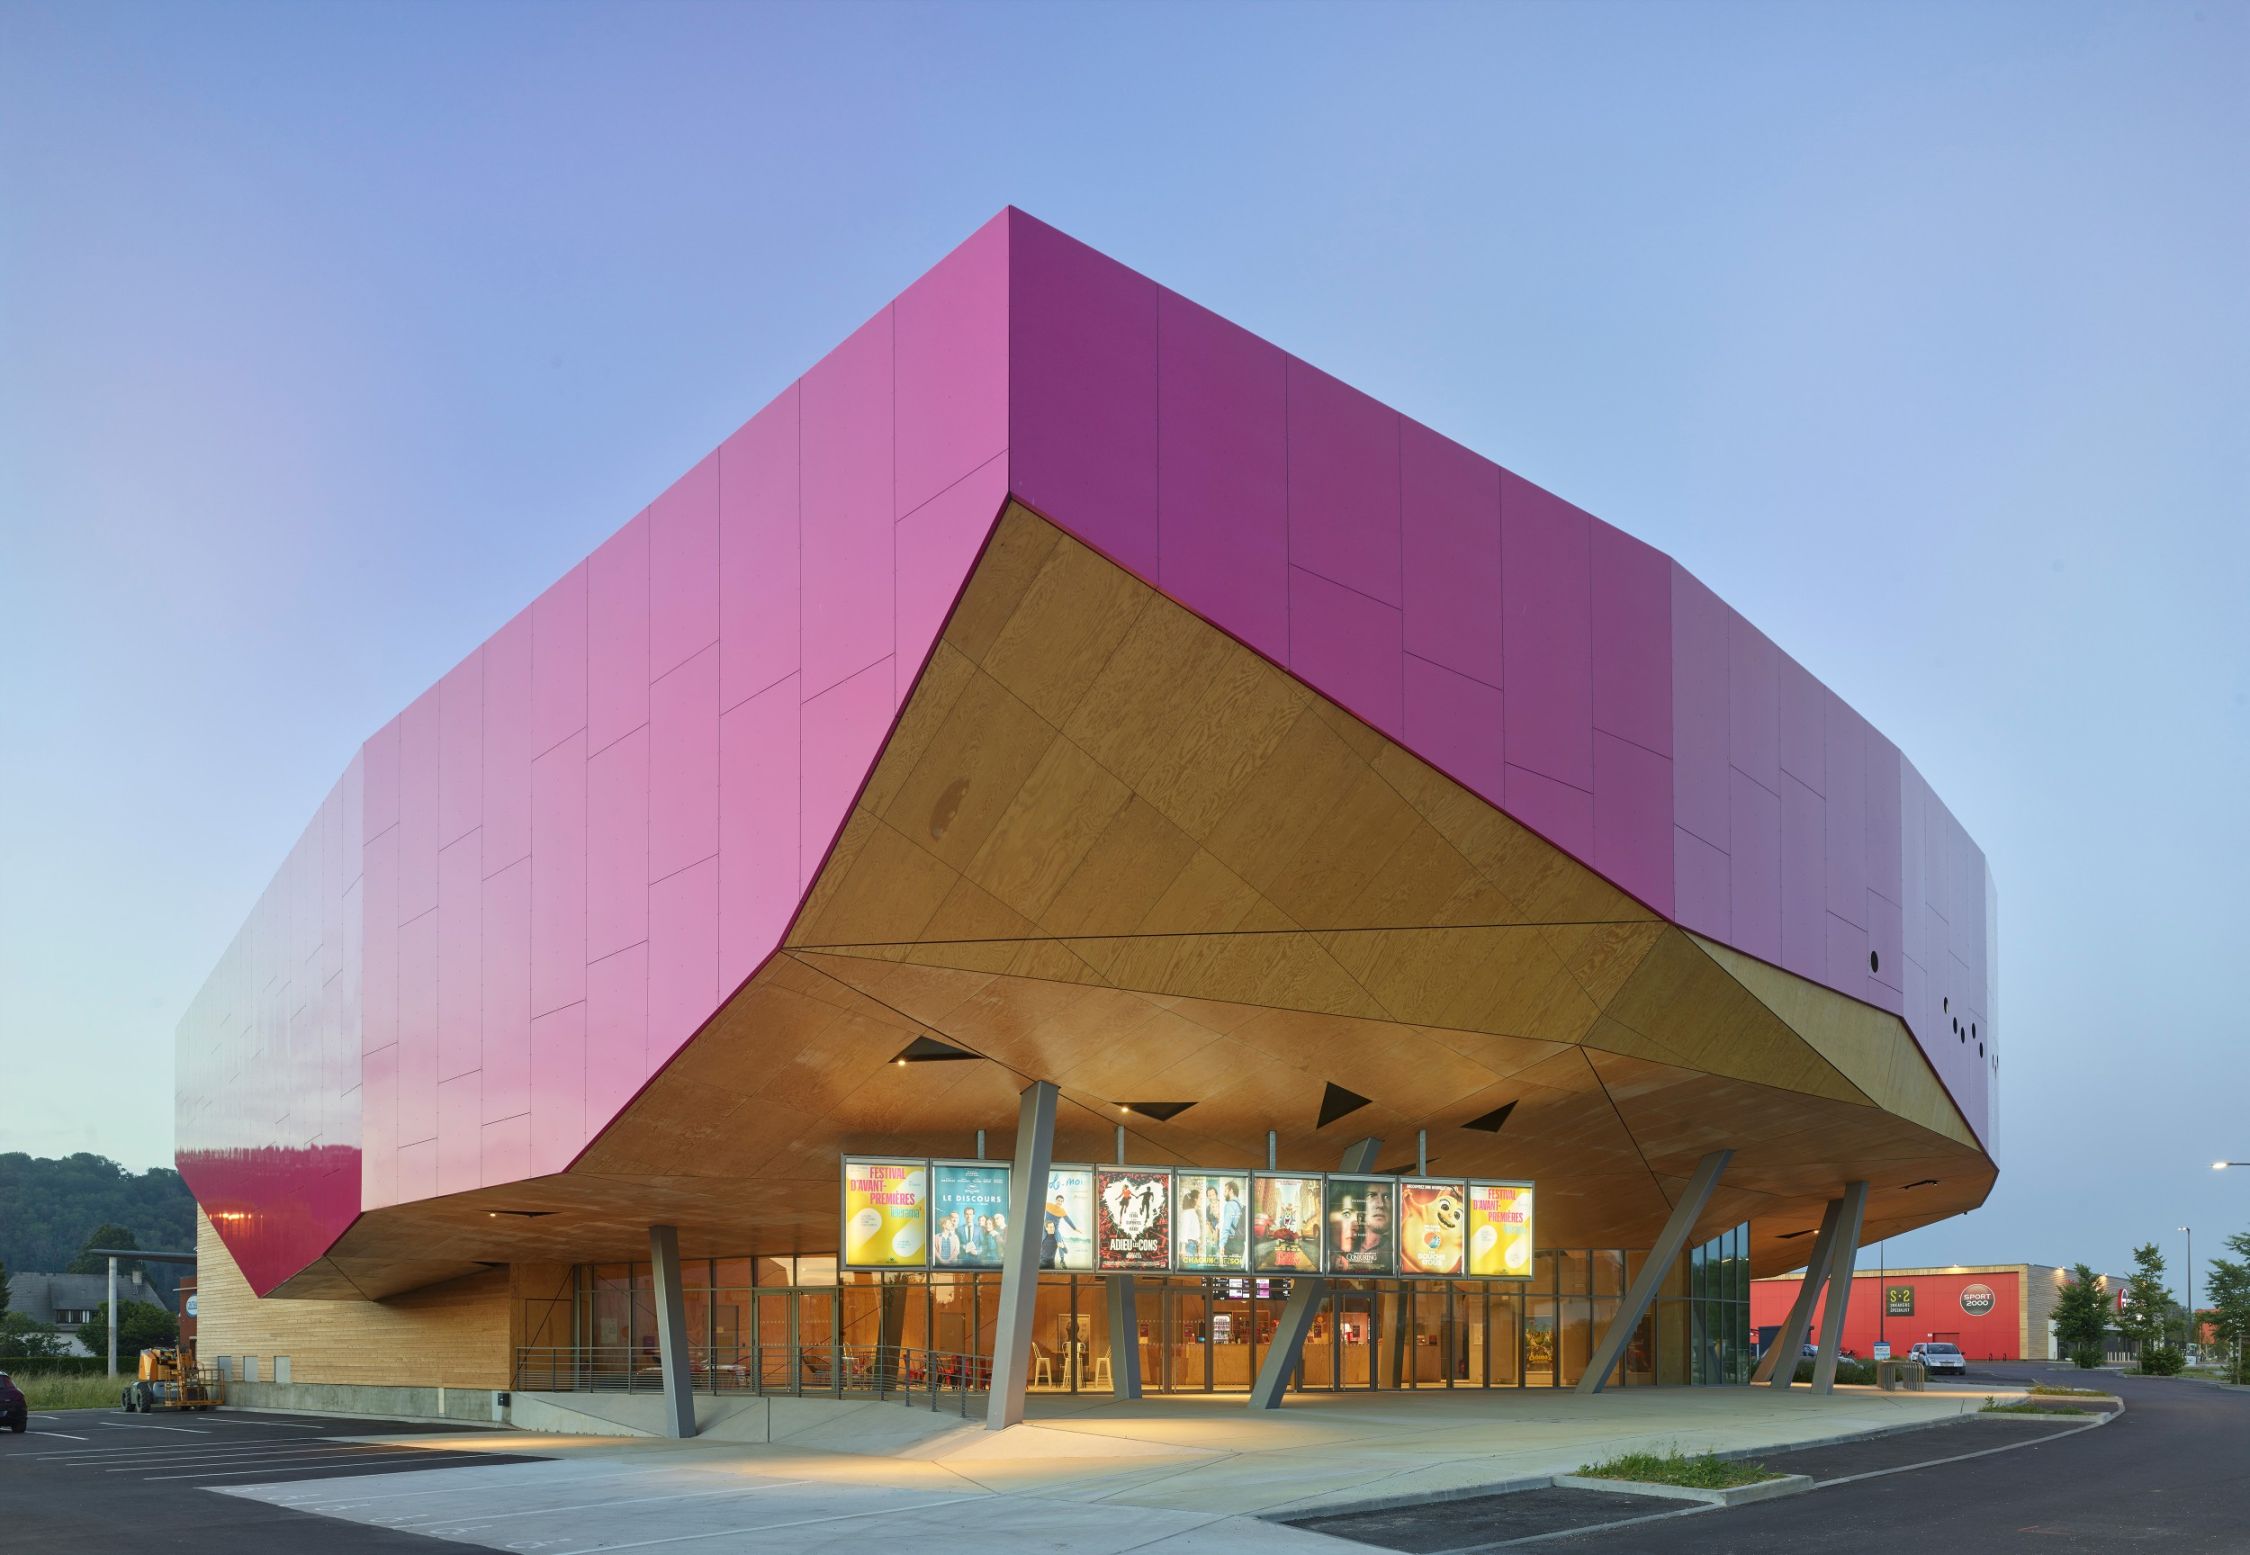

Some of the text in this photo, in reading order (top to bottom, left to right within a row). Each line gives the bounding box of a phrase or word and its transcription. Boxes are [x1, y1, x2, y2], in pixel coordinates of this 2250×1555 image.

[869, 1167, 906, 1179] FESTIVAL
[850, 1179, 887, 1192] D'AVANT-
[870, 1190, 915, 1205] PREMIÈRES
[956, 1195, 1001, 1203] DISCOURS
[1488, 1188, 1516, 1200] FESTIVAL
[1473, 1199, 1501, 1211] D'AVANT-
[1488, 1210, 1523, 1223] PREMIÈRES
[1110, 1238, 1132, 1250] ADIEU
[1139, 1239, 1158, 1251] CONS
